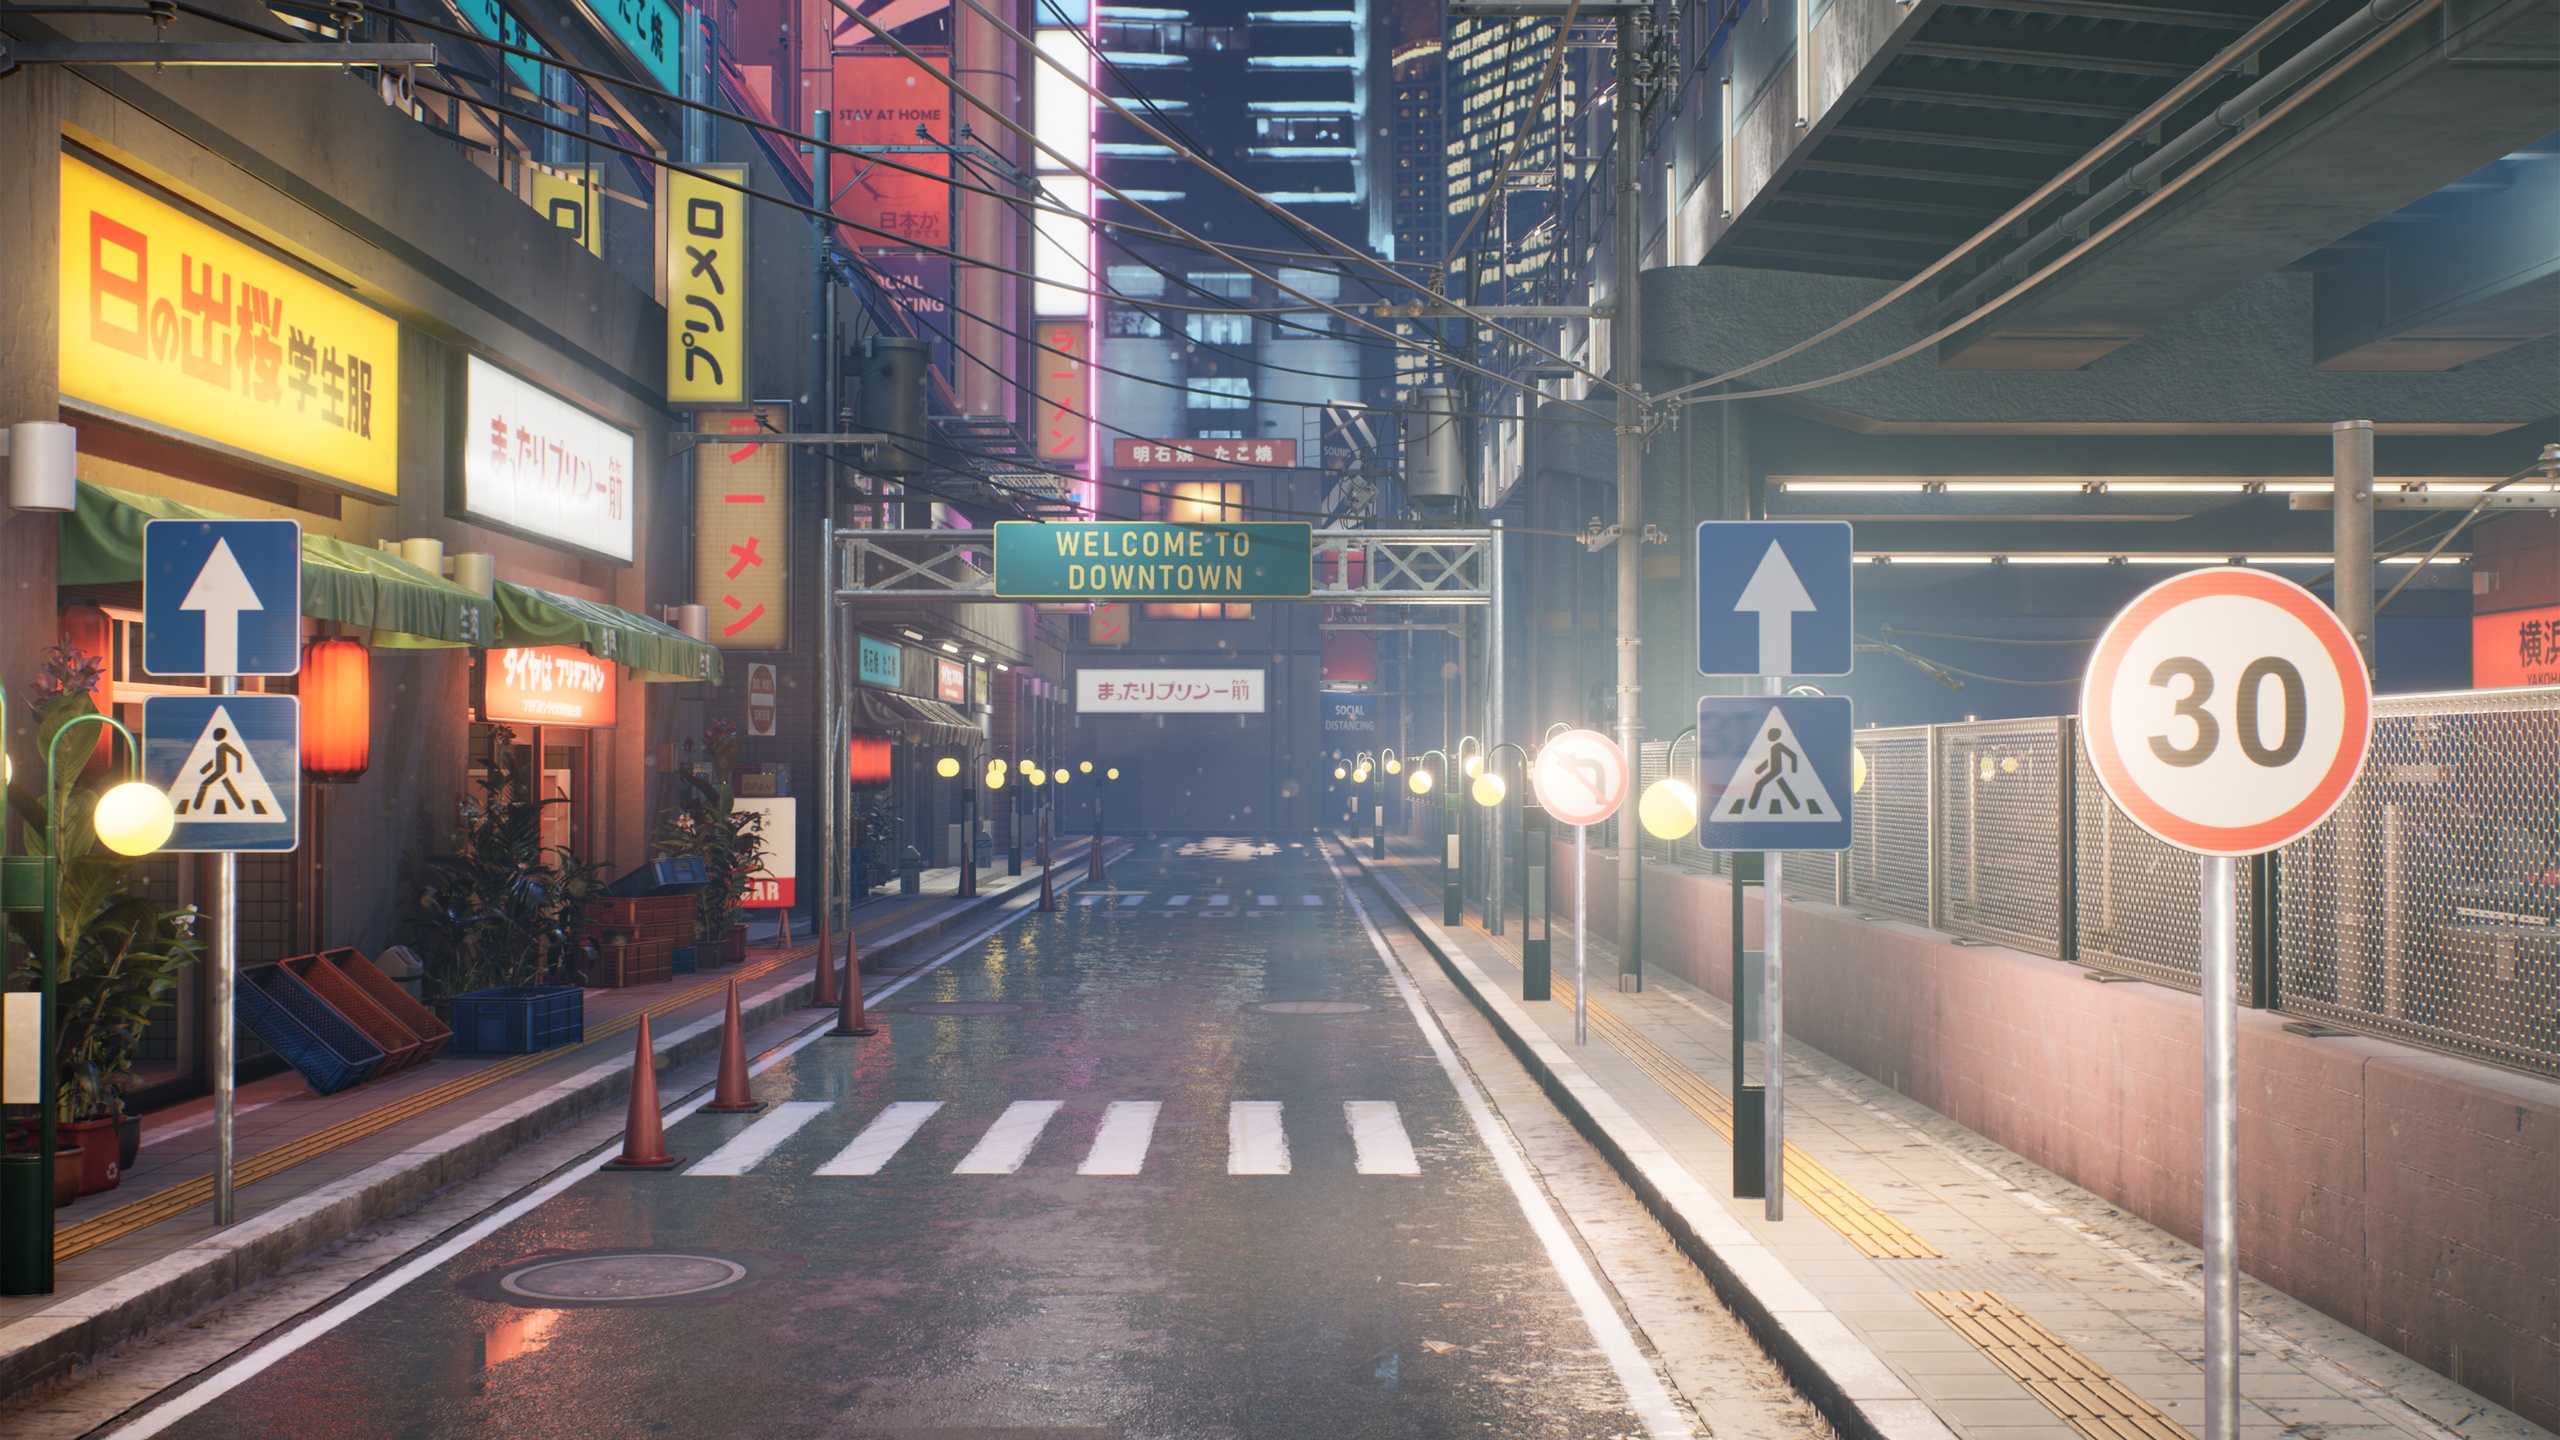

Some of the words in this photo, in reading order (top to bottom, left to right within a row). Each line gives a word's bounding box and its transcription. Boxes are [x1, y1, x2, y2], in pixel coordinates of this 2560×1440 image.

[839, 109, 873, 121] STAY
[876, 109, 895, 121] AT
[898, 109, 941, 121] HOME
[880, 211, 939, 230] 日本が
[1051, 329, 1076, 454] ラーメン
[1133, 445, 1194, 463] 明石焼
[1214, 445, 1273, 462] たこ焼
[723, 418, 766, 638] ラーメン
[1056, 531, 1204, 557] WELCOME
[1214, 531, 1250, 557] TO
[1068, 564, 1243, 590] DOWNTOWN
[1335, 705, 1365, 716] SOCIAL
[2147, 656, 2307, 768] 30
[1325, 720, 1375, 731] DISTANCING
[743, 782, 773, 791] OPEN
